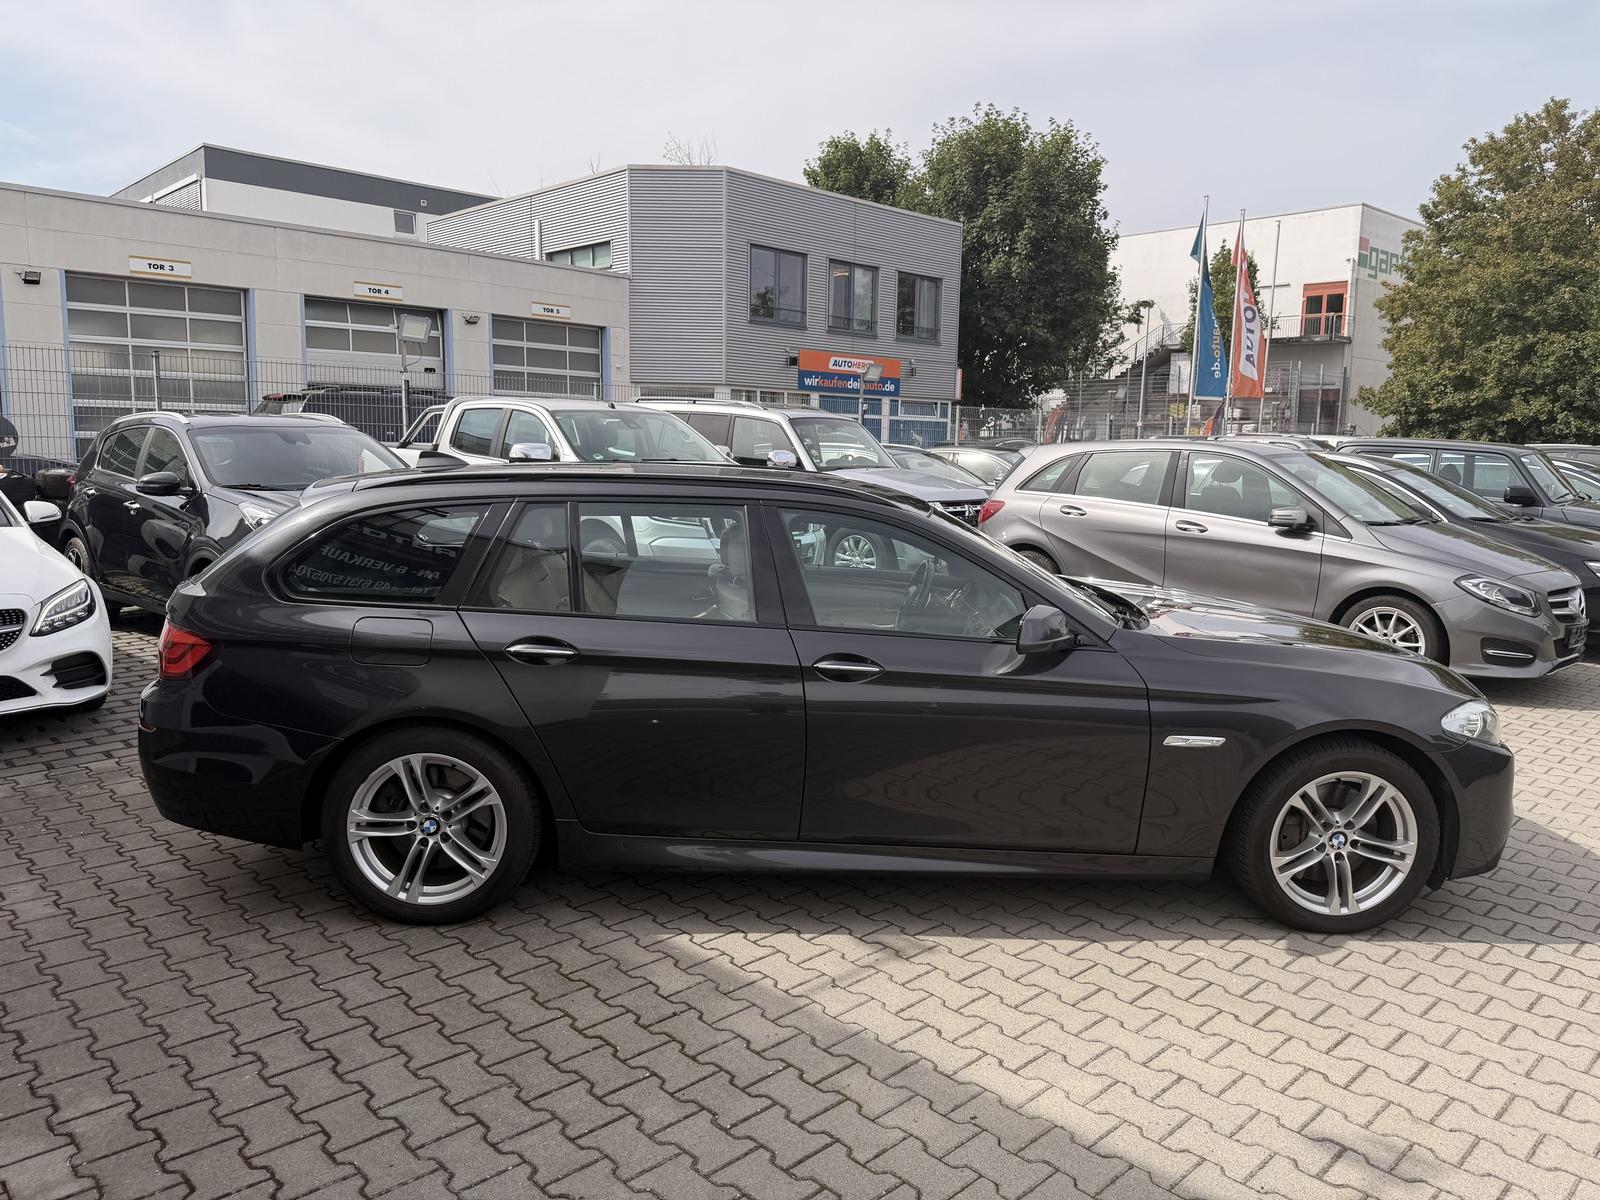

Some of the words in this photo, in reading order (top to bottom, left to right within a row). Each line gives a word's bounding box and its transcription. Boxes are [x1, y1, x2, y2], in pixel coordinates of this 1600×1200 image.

[147, 262, 166, 271] TOR
[168, 264, 175, 272] 3
[367, 287, 382, 295] TOR
[803, 375, 895, 393] wirkaufendeiauto.de
